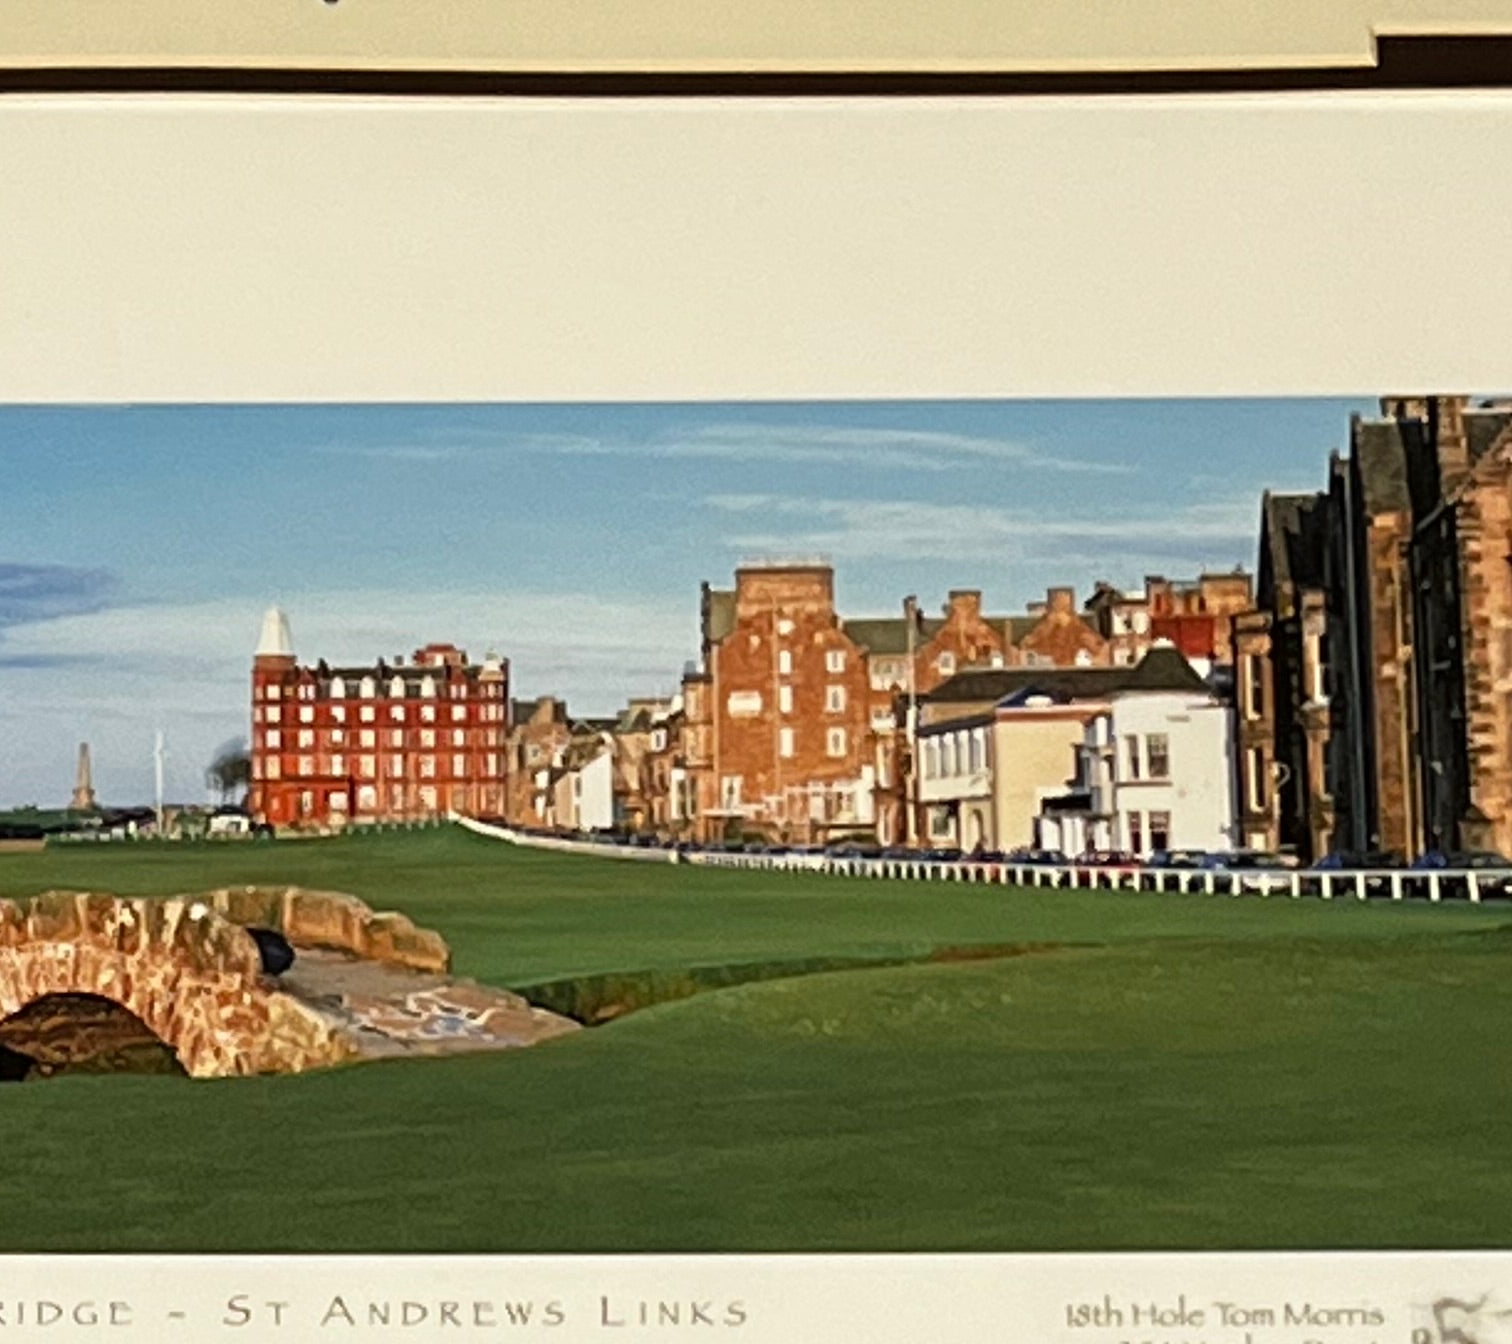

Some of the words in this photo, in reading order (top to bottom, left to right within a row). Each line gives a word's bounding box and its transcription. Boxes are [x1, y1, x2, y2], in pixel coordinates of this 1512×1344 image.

[1065, 1293, 1124, 1329] 18th
[1130, 1293, 1206, 1328] Hole
[1213, 1300, 1276, 1328] Tom
[1282, 1301, 1386, 1328] Morris
